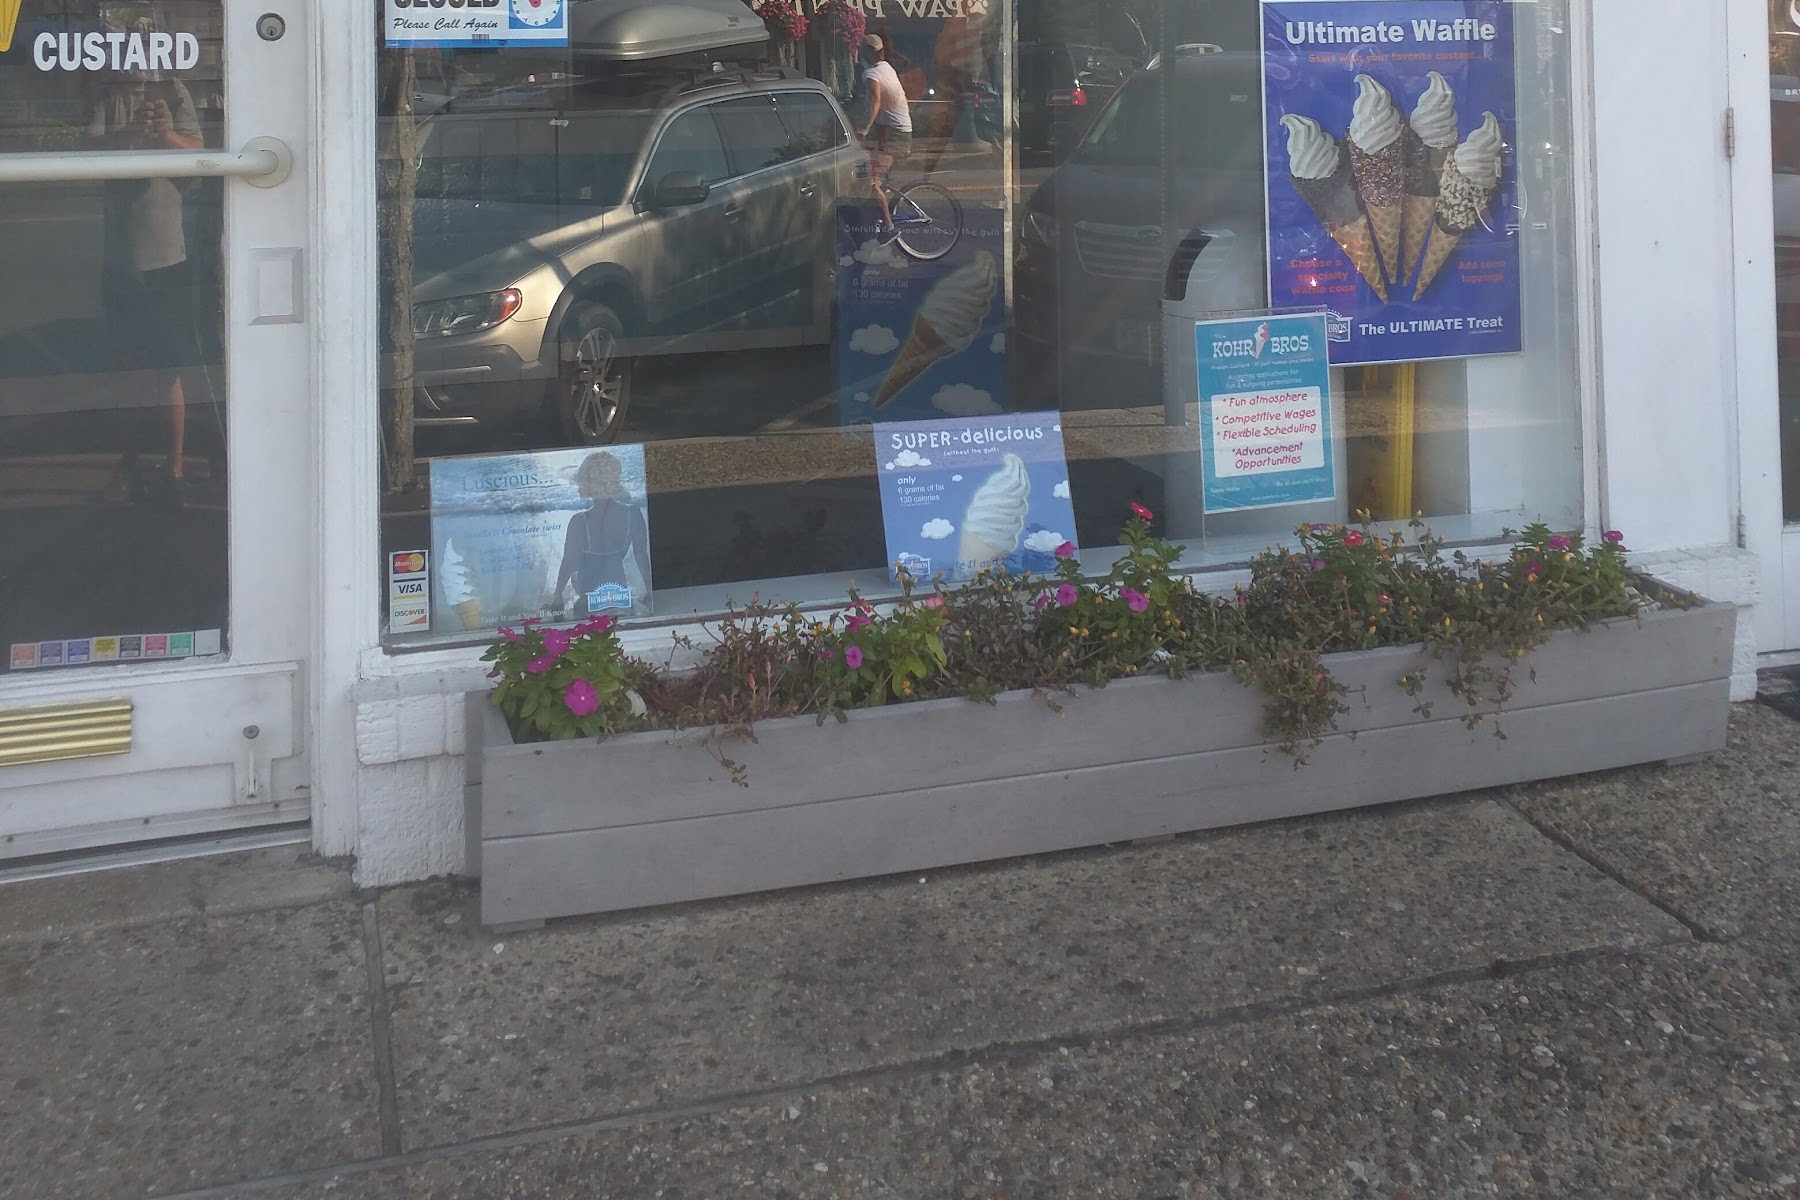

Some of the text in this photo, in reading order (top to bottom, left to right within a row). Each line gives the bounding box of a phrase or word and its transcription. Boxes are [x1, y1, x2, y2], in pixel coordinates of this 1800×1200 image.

[393, 18, 499, 30] Please Call Again
[1286, 18, 1495, 44] Ultimate Waffle
[33, 32, 199, 71] CUSTARD
[1309, 53, 1335, 63] Start
[1365, 54, 1388, 64] your
[1392, 52, 1432, 61] favorite
[1290, 259, 1331, 268] Choose
[1459, 261, 1478, 269] Add
[1298, 271, 1348, 282] specialty
[1291, 284, 1355, 295] waffle cone
[1328, 322, 1347, 333] BROS
[1359, 324, 1385, 336] The
[1390, 318, 1462, 334] ULTIMATE
[1467, 316, 1503, 328] Treat
[1212, 335, 1309, 358] KOHR BROS
[1229, 392, 1308, 407] Fun atmosphere
[1222, 408, 1316, 425] Competitive Wages
[1223, 423, 1317, 440] Flexible Scheduling
[891, 426, 1044, 450] SUPER-delicious
[1235, 455, 1302, 471] Opportunities
[897, 475, 917, 486] only
[904, 486, 926, 495] grams
[926, 484, 935, 492] of
[935, 484, 945, 492] fat
[899, 494, 940, 504] 130 calories
[501, 525, 540, 537] Chocolate
[398, 583, 422, 594] VISA
[394, 608, 425, 617] DISCOVER
[480, 616, 499, 624] Taste
[508, 614, 522, 622] and
